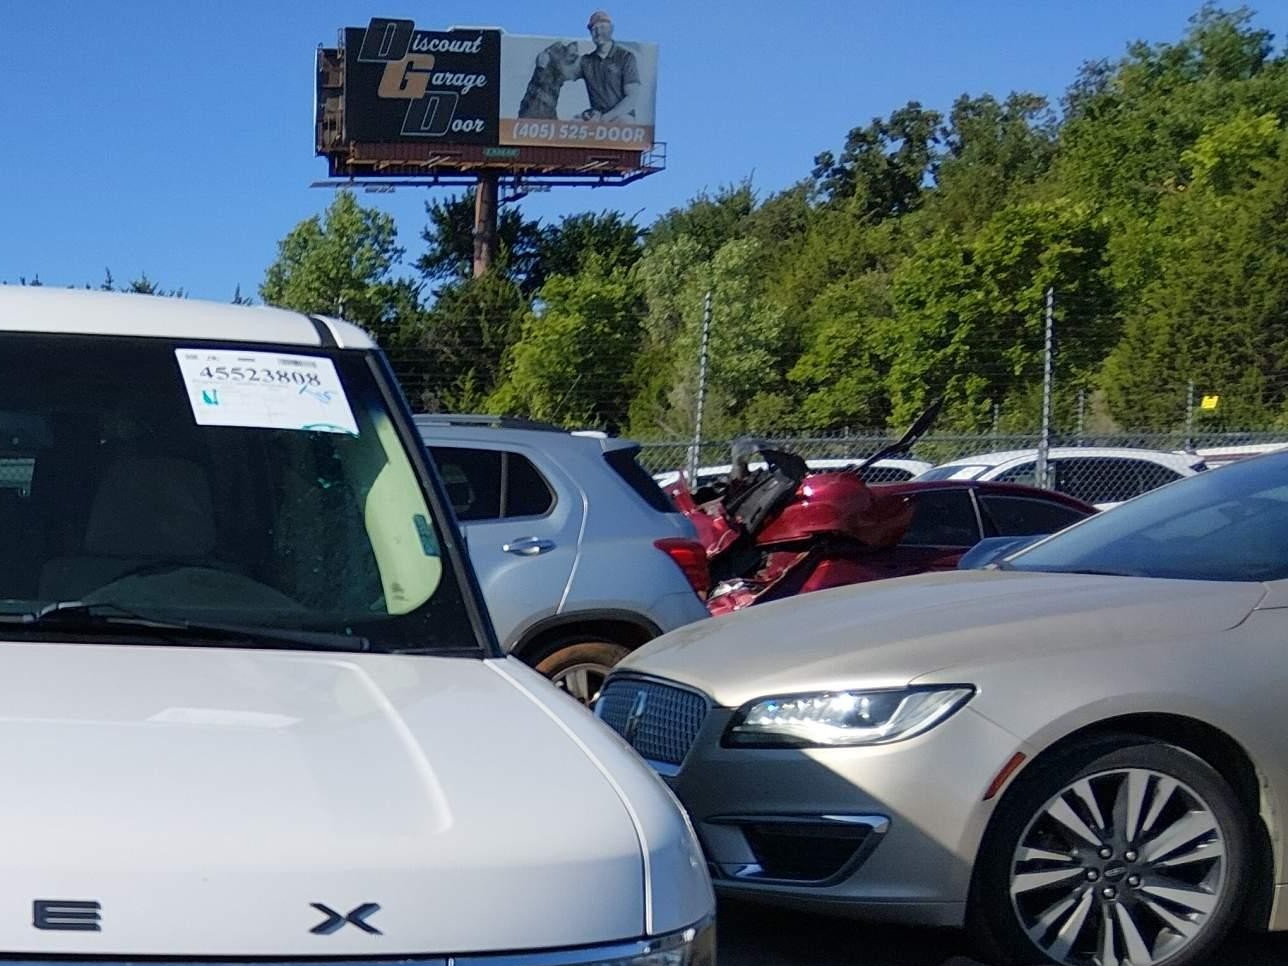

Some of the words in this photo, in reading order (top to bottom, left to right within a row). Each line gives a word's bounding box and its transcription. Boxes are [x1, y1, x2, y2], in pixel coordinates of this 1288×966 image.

[357, 17, 483, 63] Discount
[377, 54, 488, 98] Garage
[400, 91, 485, 137] Door
[513, 122, 555, 140] (405)
[559, 124, 645, 142] 525-DOOR
[199, 366, 321, 387] 45523808
